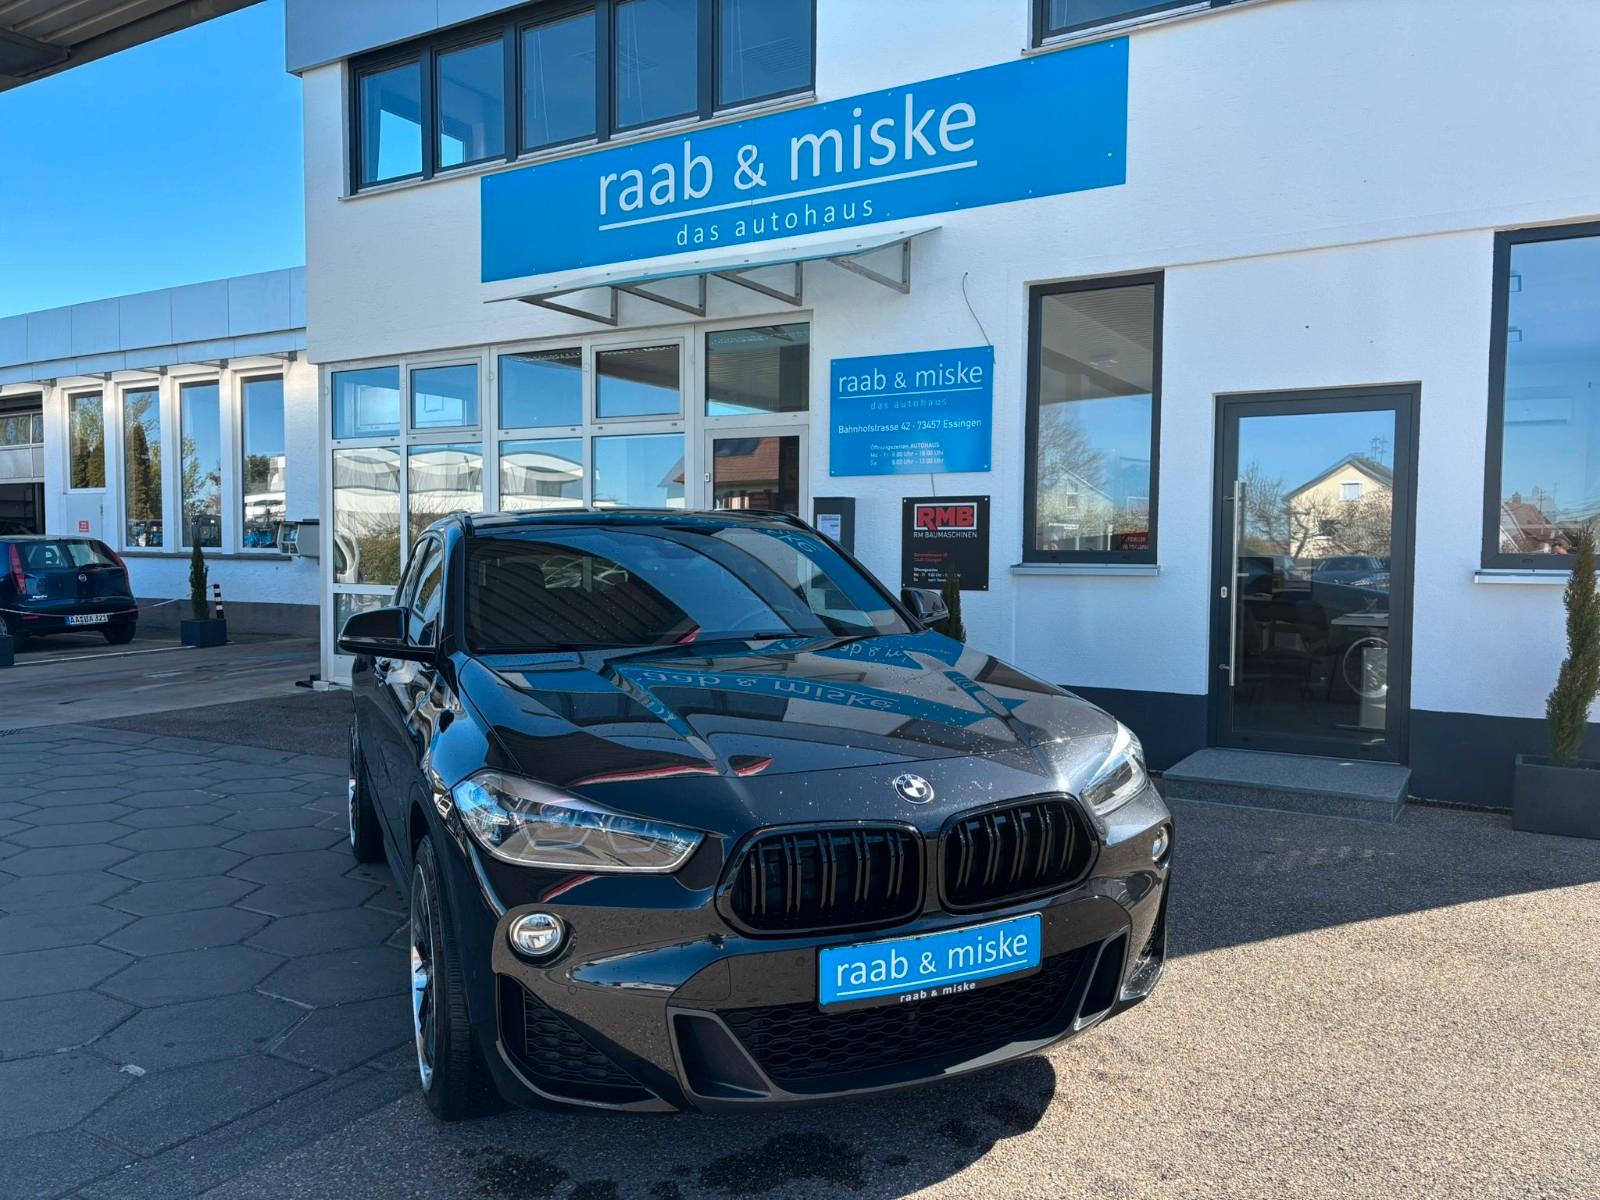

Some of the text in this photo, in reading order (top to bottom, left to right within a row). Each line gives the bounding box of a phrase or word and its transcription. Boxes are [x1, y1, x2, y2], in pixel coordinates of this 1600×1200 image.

[599, 93, 977, 215] raab & miske
[676, 198, 874, 247] das autohaus
[838, 360, 983, 393] raab & miske
[870, 398, 948, 410] das autohaus
[838, 423, 899, 434] Bahnhofstrasse
[900, 421, 911, 431] 42
[917, 419, 941, 430] 73457
[943, 418, 983, 431] Essingen
[917, 506, 974, 531] RMB
[913, 531, 978, 539] RM BAUMASCHINEN
[836, 929, 1028, 987] raab & miske
[900, 981, 976, 1003] raab & miske
